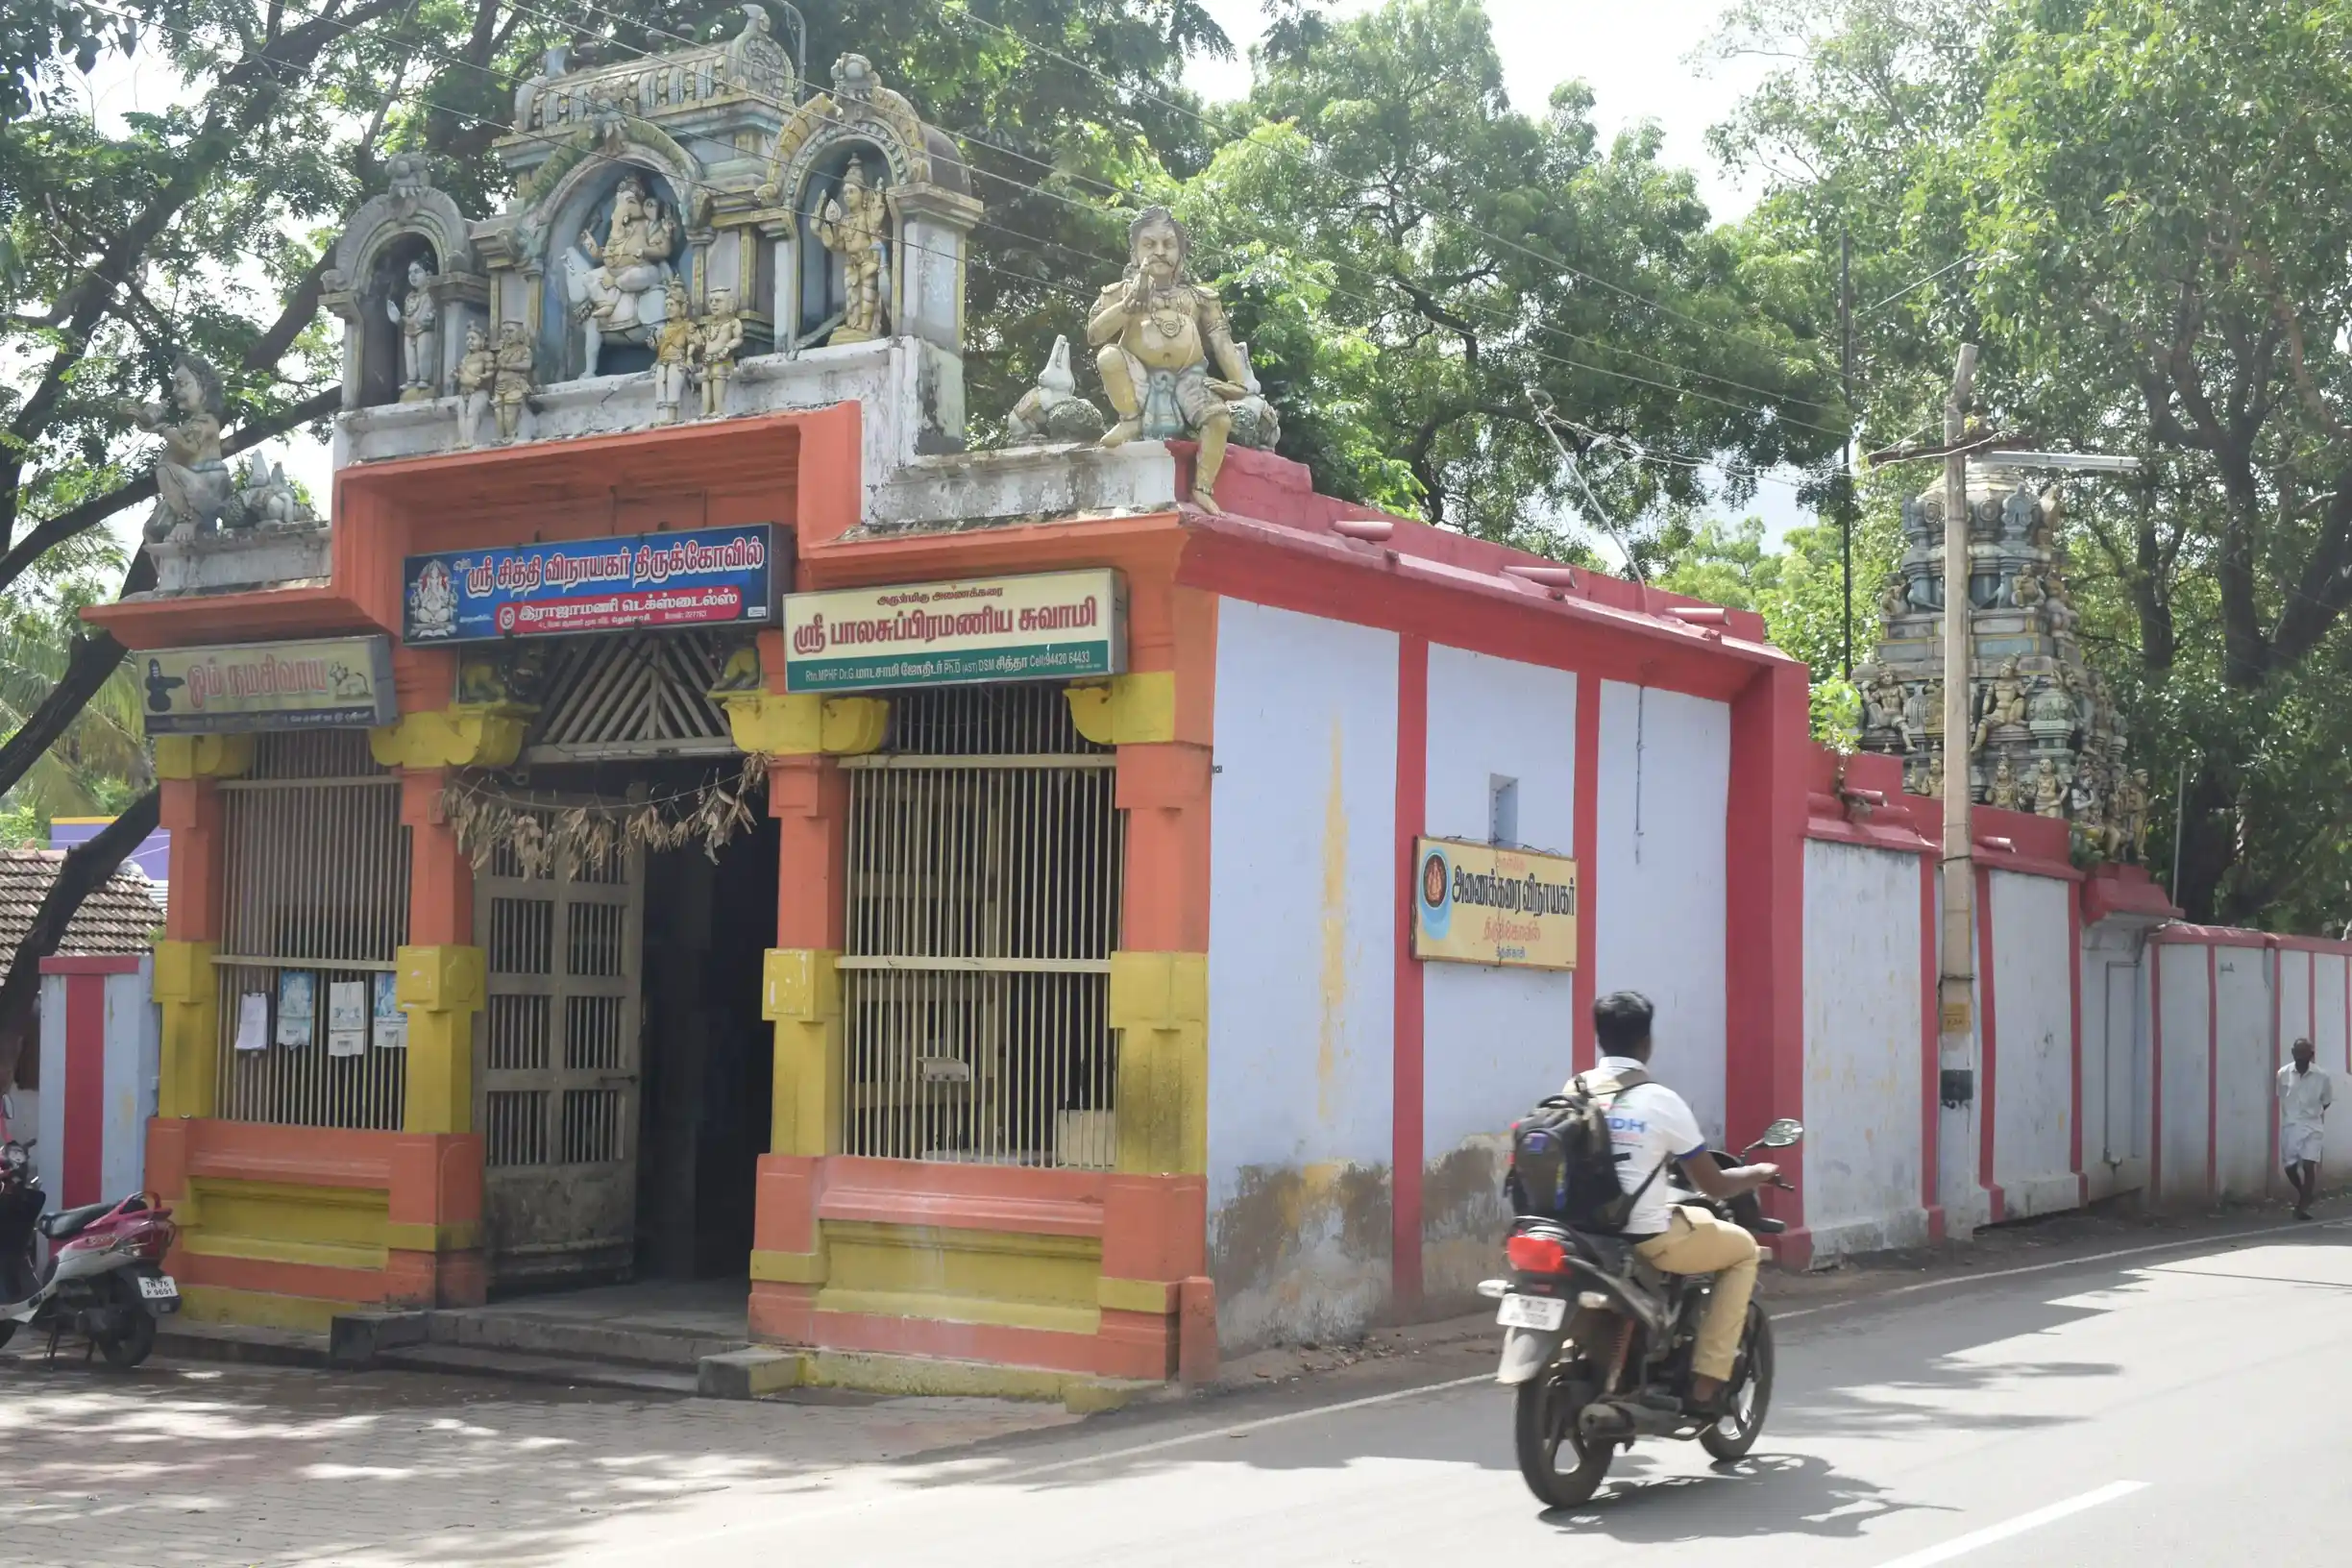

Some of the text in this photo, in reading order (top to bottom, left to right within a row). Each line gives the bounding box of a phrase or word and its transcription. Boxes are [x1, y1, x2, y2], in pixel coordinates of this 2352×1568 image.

[496, 553, 543, 599] சித்தி
[545, 546, 632, 595] விநாயகர்
[632, 535, 766, 589] திருக்கோவில்
[622, 587, 738, 612] டெக்ஸ்டைல்ஸ்
[877, 587, 1003, 606] அருள்மிகு அணைக்கரை
[794, 596, 1097, 654] ஸ்ரீ பாலசுப்பிரமணிய சுவாமி
[1452, 865, 1575, 918] அணைக்கரை விநாயகர்
